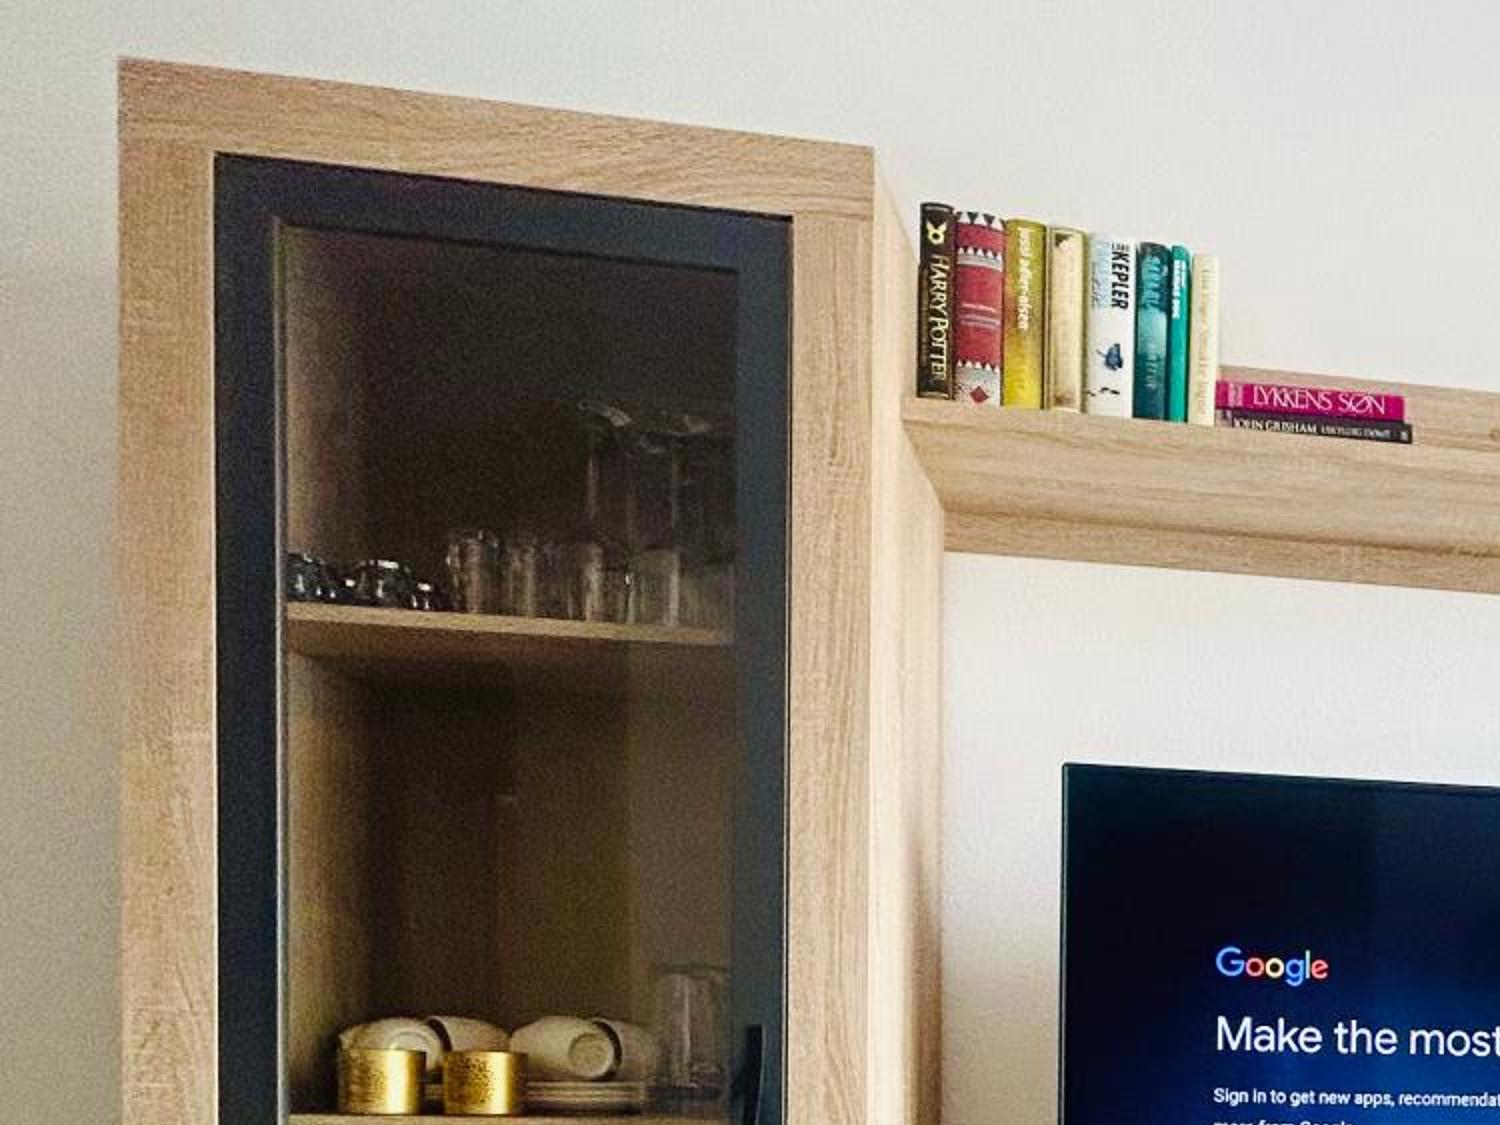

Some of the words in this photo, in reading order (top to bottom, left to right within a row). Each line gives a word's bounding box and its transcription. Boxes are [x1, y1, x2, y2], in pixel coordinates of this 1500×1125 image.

[929, 255, 950, 315] HARRY
[1111, 250, 1129, 310] KEPLER
[929, 316, 949, 381] POTTER
[1253, 384, 1332, 411] LYKKENS
[1338, 393, 1385, 415] SØN
[1215, 946, 1329, 987] Google
[1216, 1015, 1323, 1053] Make
[1333, 1019, 1398, 1055] the
[1213, 1087, 1249, 1106] Sign
[1270, 1089, 1287, 1104] to
[1290, 1090, 1315, 1107] get
[1318, 1092, 1350, 1105] new
[1354, 1092, 1395, 1109] apps,
